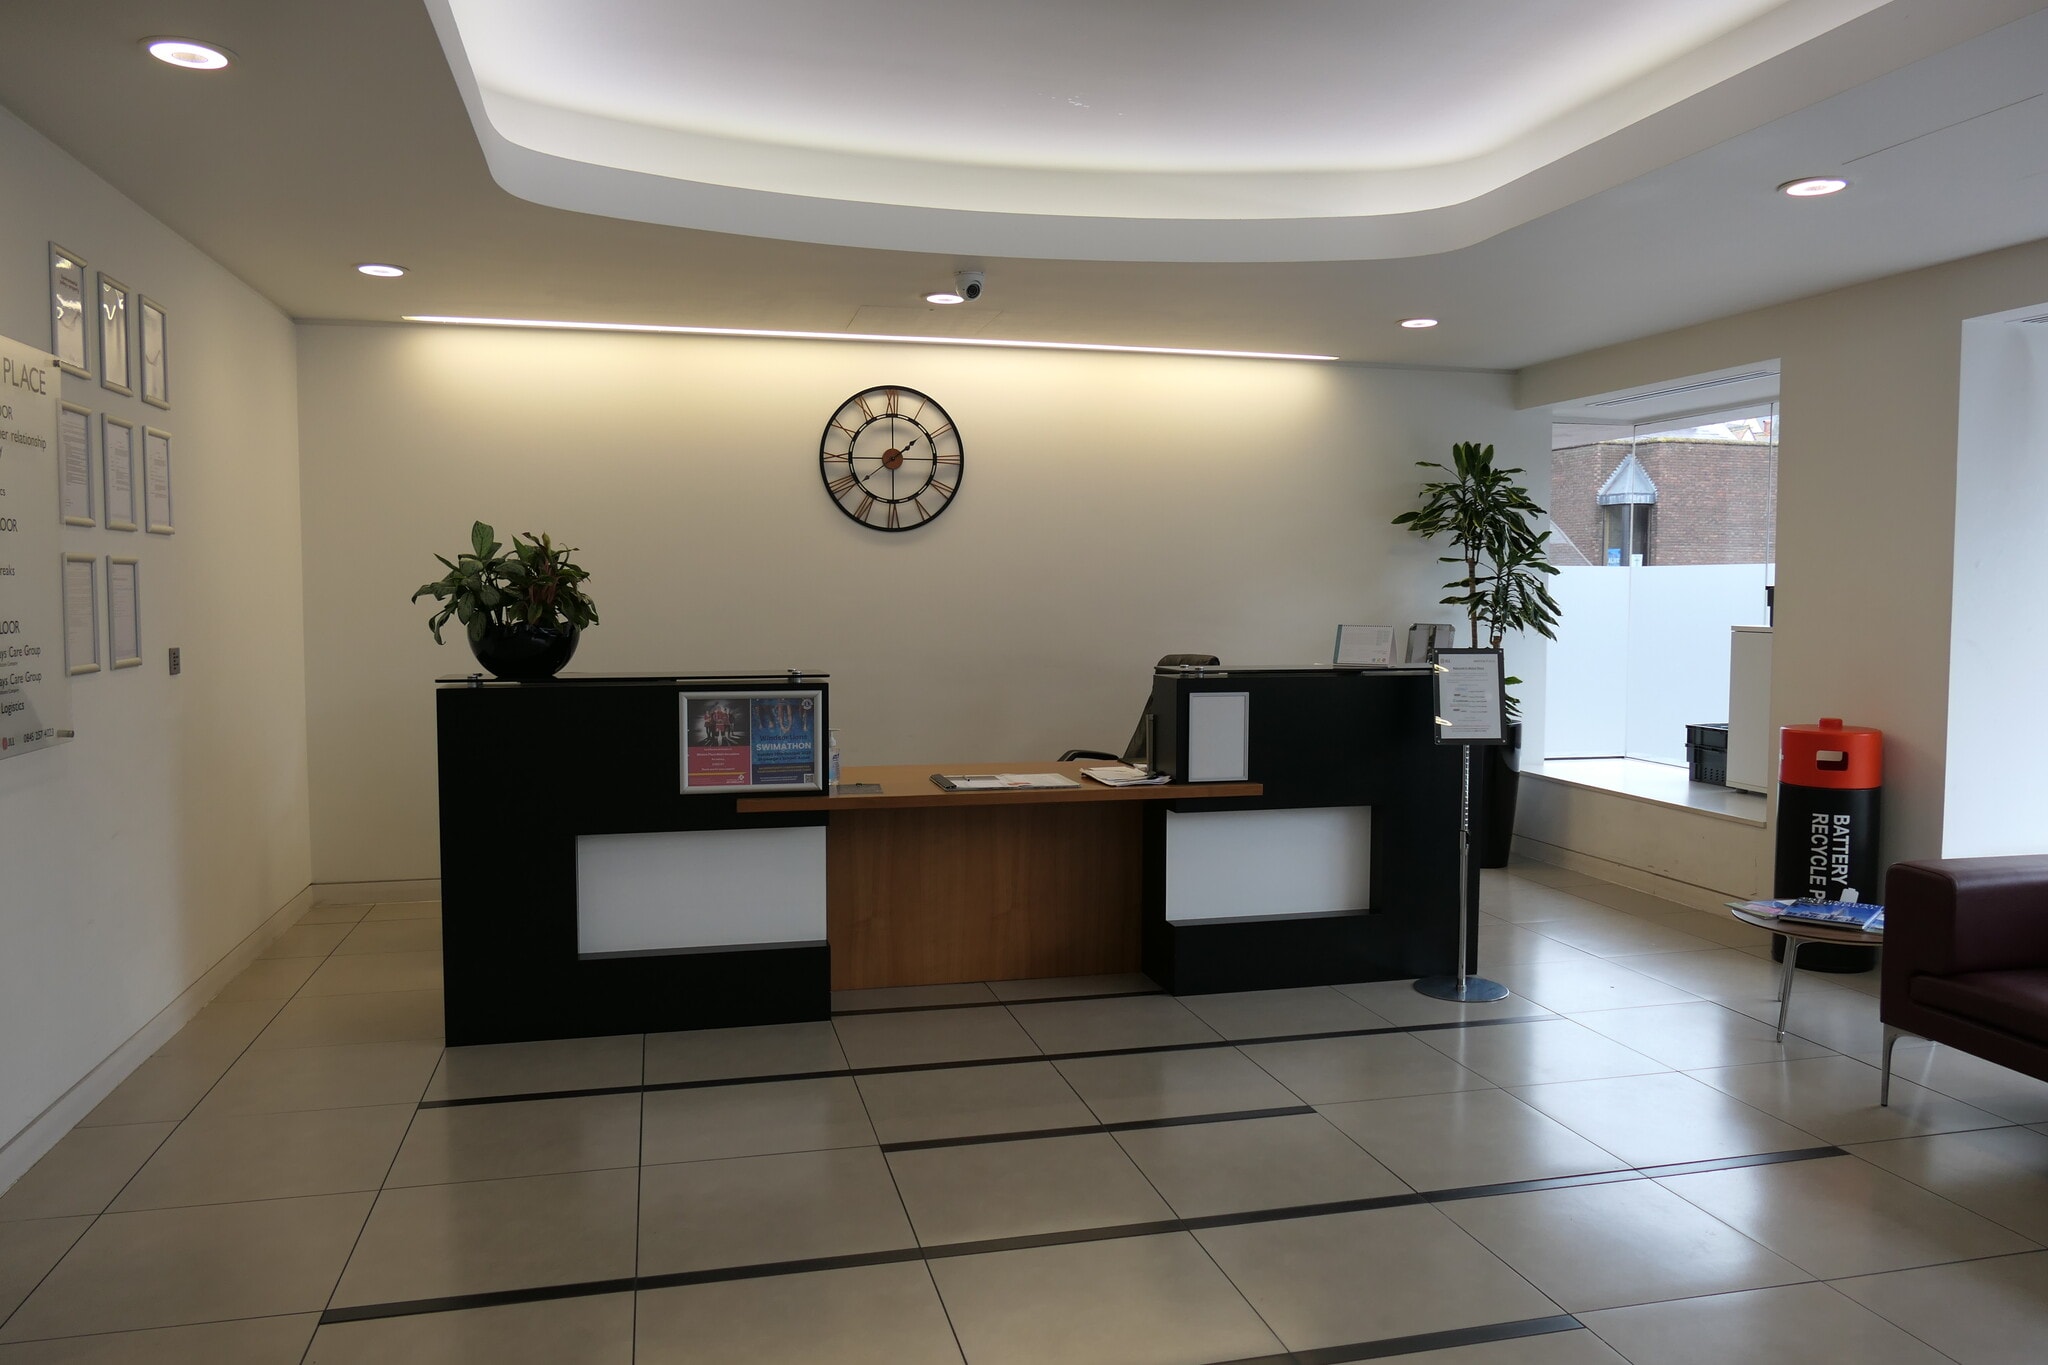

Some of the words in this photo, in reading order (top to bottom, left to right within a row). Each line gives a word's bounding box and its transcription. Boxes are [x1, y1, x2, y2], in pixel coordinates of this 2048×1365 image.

[3, 357, 46, 395] PLACE
[10, 431, 46, 452] relationship
[9, 645, 22, 658] Care
[24, 644, 41, 658] Group
[10, 673, 23, 685] Care
[25, 671, 42, 684] Group
[1, 700, 24, 717] Logistics
[756, 742, 812, 751] SWIMATHON
[1809, 813, 1829, 885] RECYCLE
[1830, 814, 1851, 886] BATTERY
